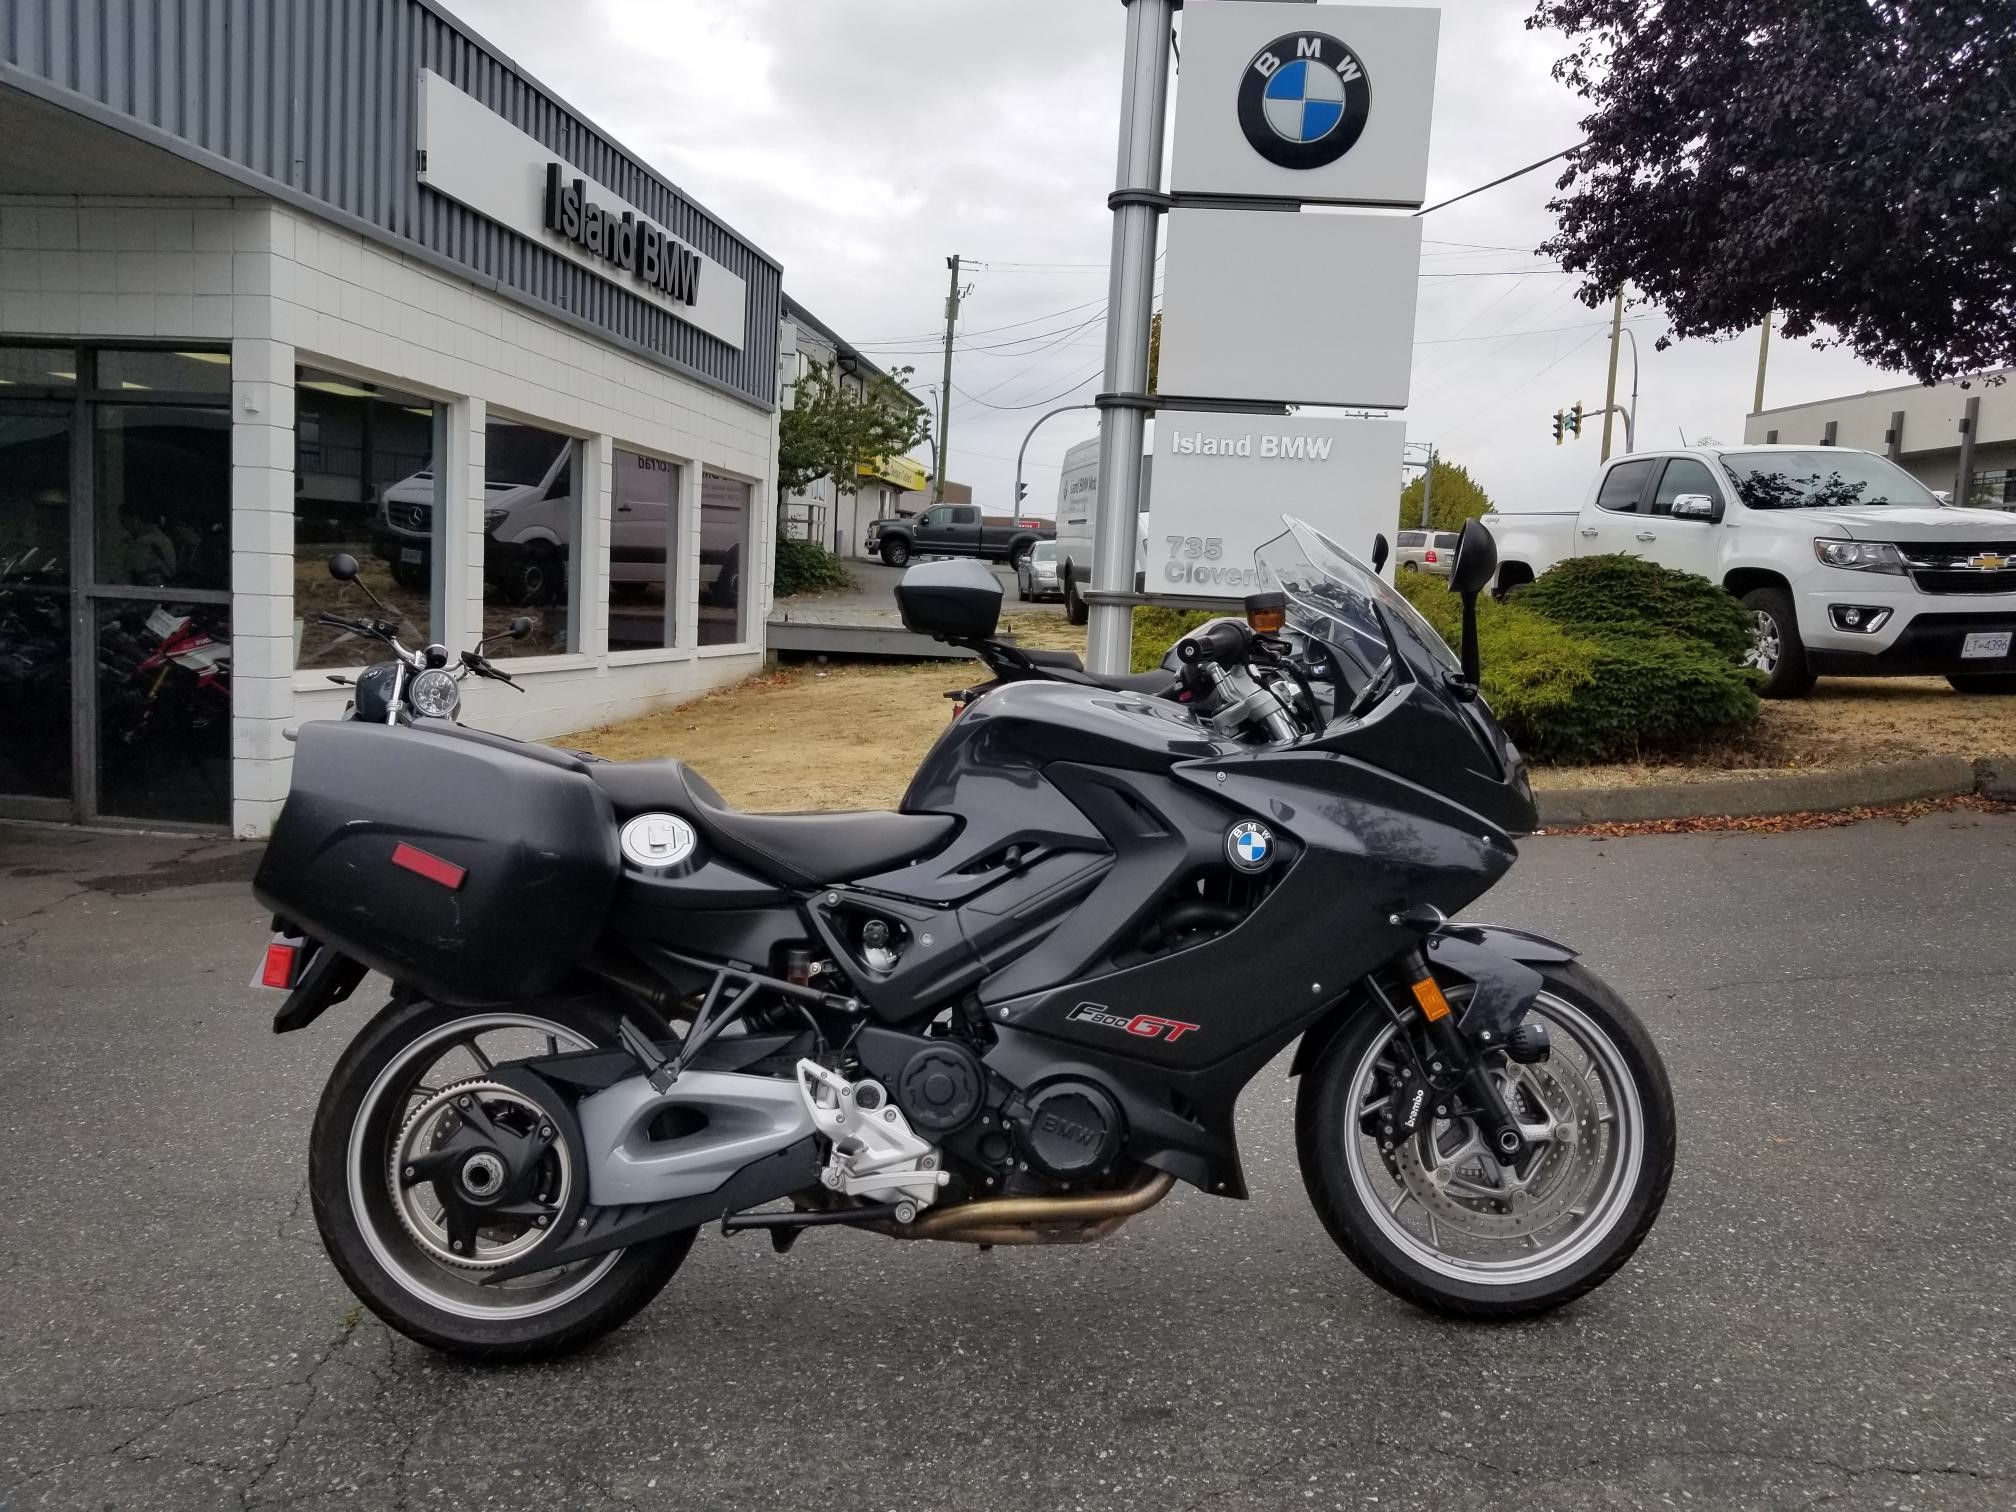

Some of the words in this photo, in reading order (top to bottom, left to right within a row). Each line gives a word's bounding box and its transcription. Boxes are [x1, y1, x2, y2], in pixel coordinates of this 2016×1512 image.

[1254, 37, 1362, 83] BMW
[545, 162, 635, 272] Island
[636, 220, 703, 307] BMW
[1171, 431, 1252, 457] Island
[1260, 435, 1333, 460] BMW
[1166, 536, 1223, 560] 735
[1233, 823, 1272, 840] BMW
[1404, 1089, 1425, 1128] brembo
[1041, 1114, 1096, 1146] BMW
